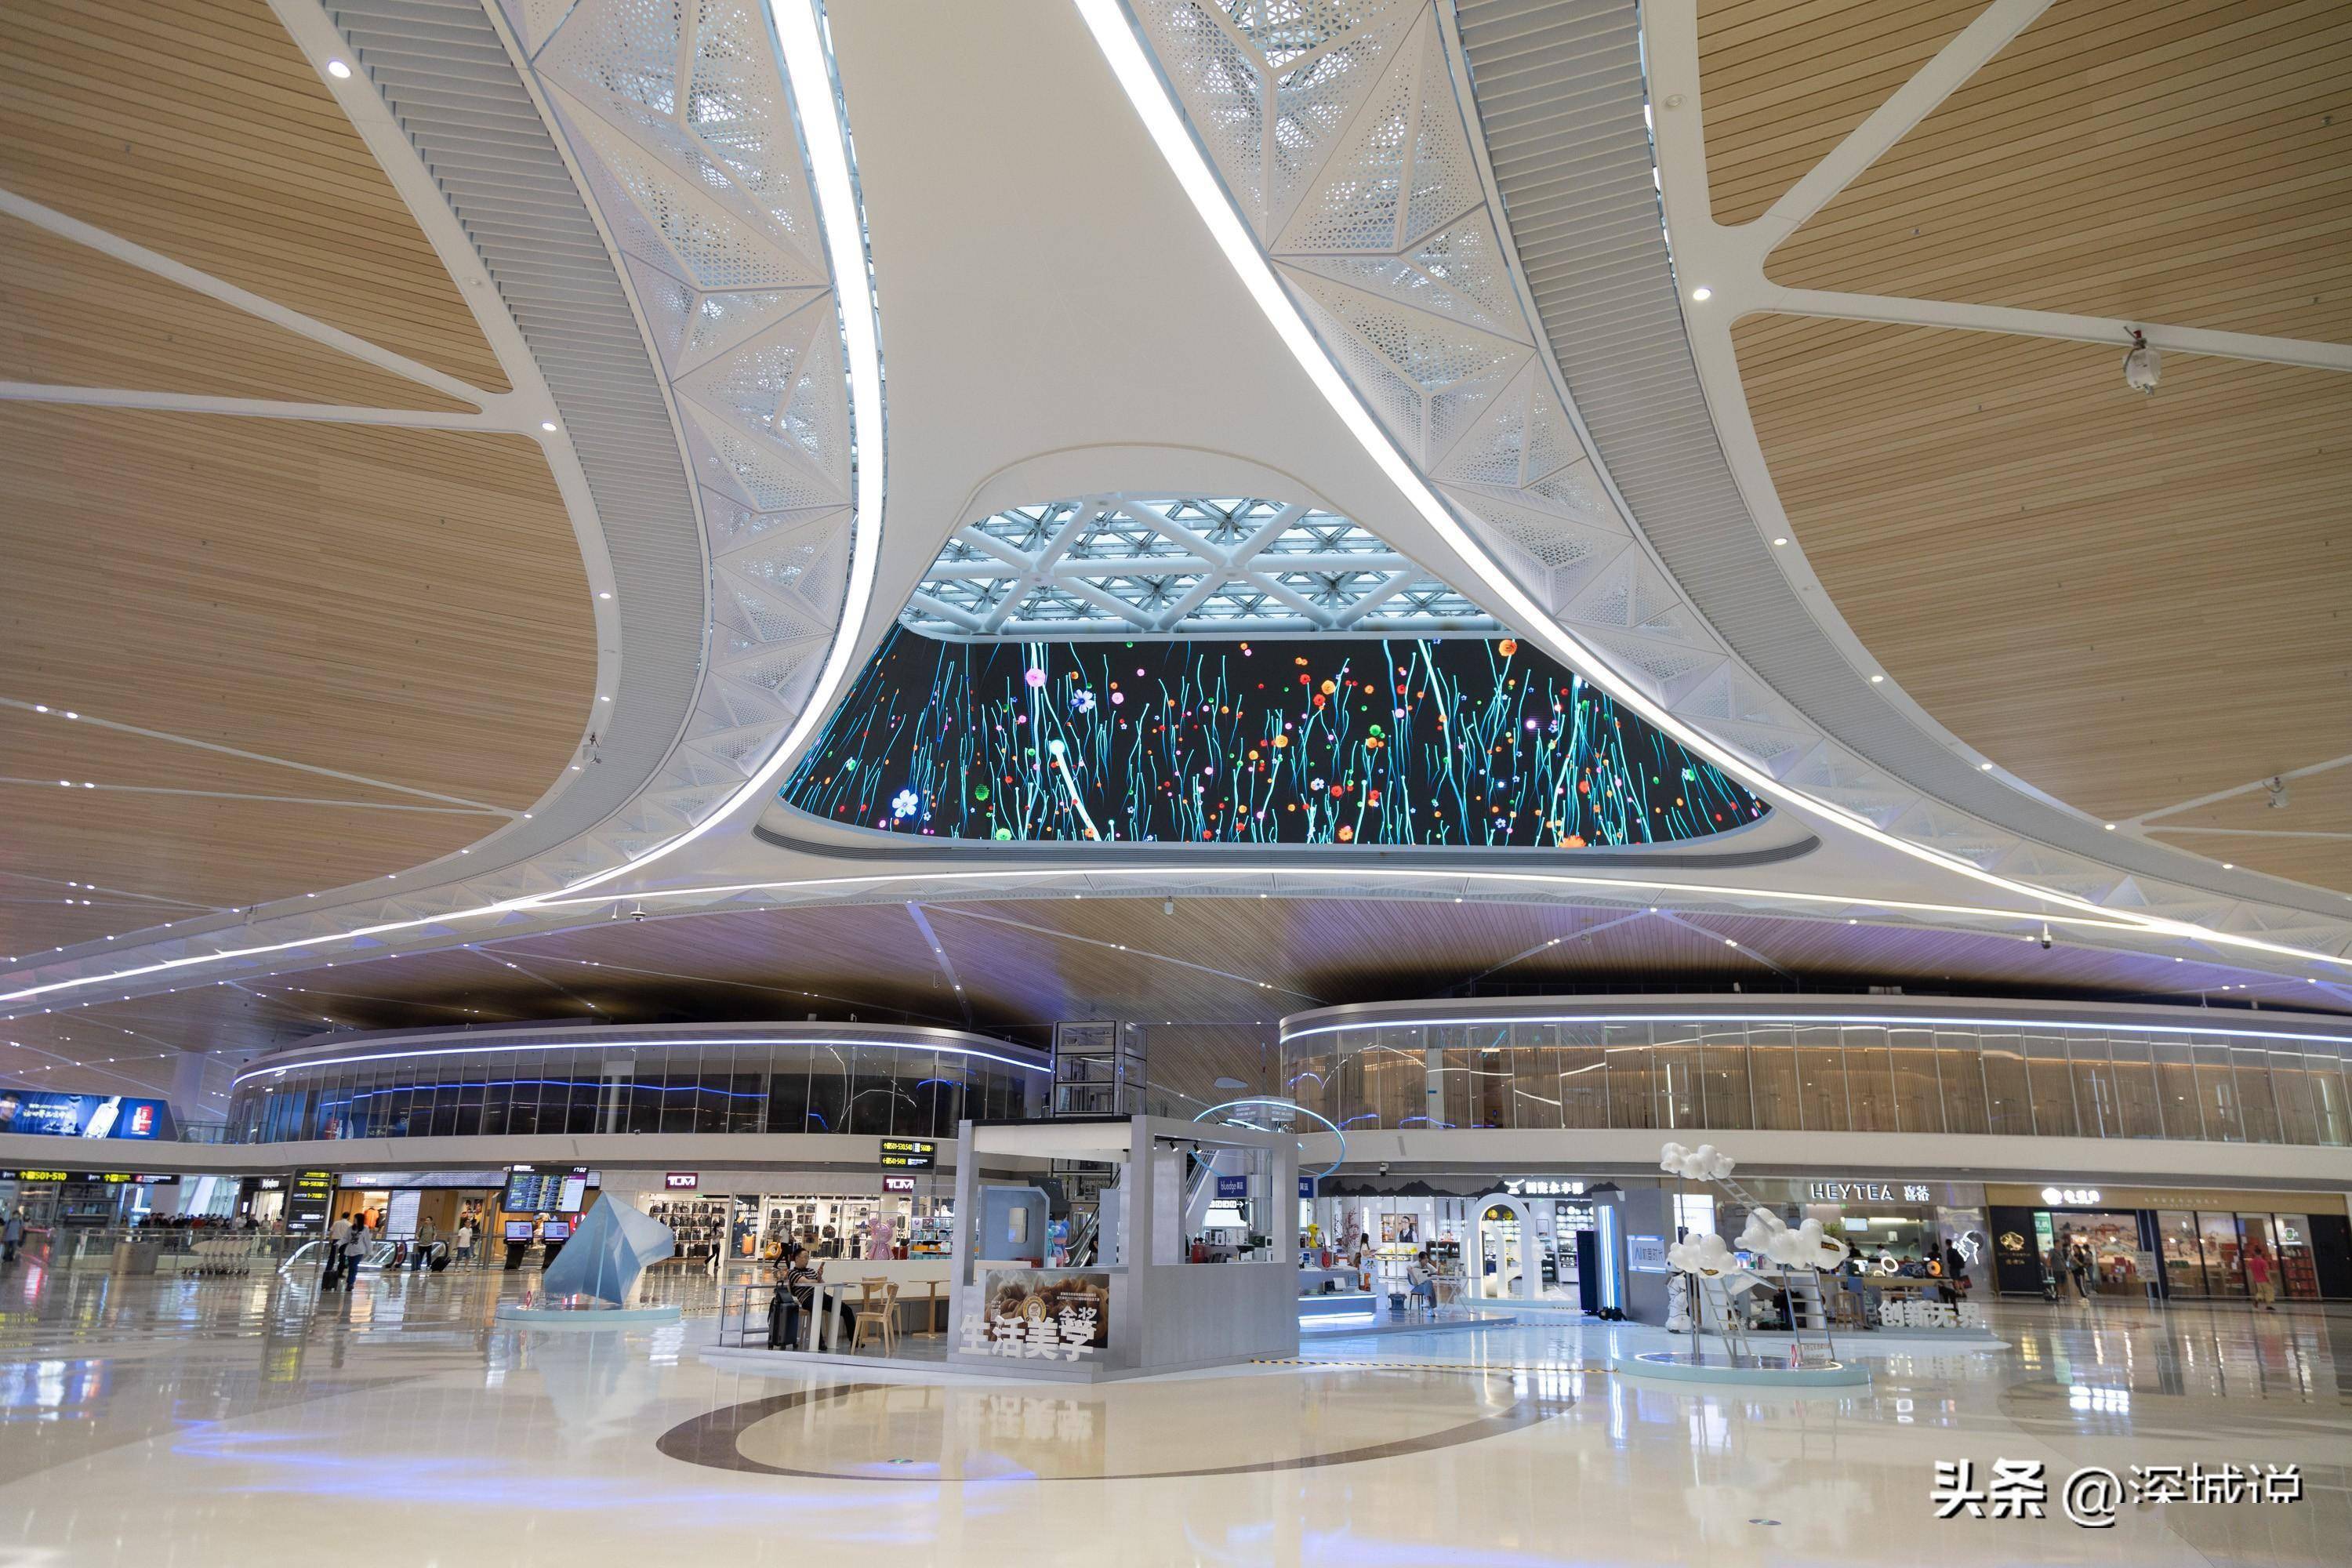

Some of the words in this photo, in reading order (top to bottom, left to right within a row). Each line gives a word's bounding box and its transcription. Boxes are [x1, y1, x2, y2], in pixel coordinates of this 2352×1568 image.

[1810, 1182, 1895, 1200] HEYTEA
[1904, 1185, 1930, 1202] 喜茶
[1878, 1299, 1981, 1328] 创新无界
[959, 1314, 1097, 1362] 生活美学
